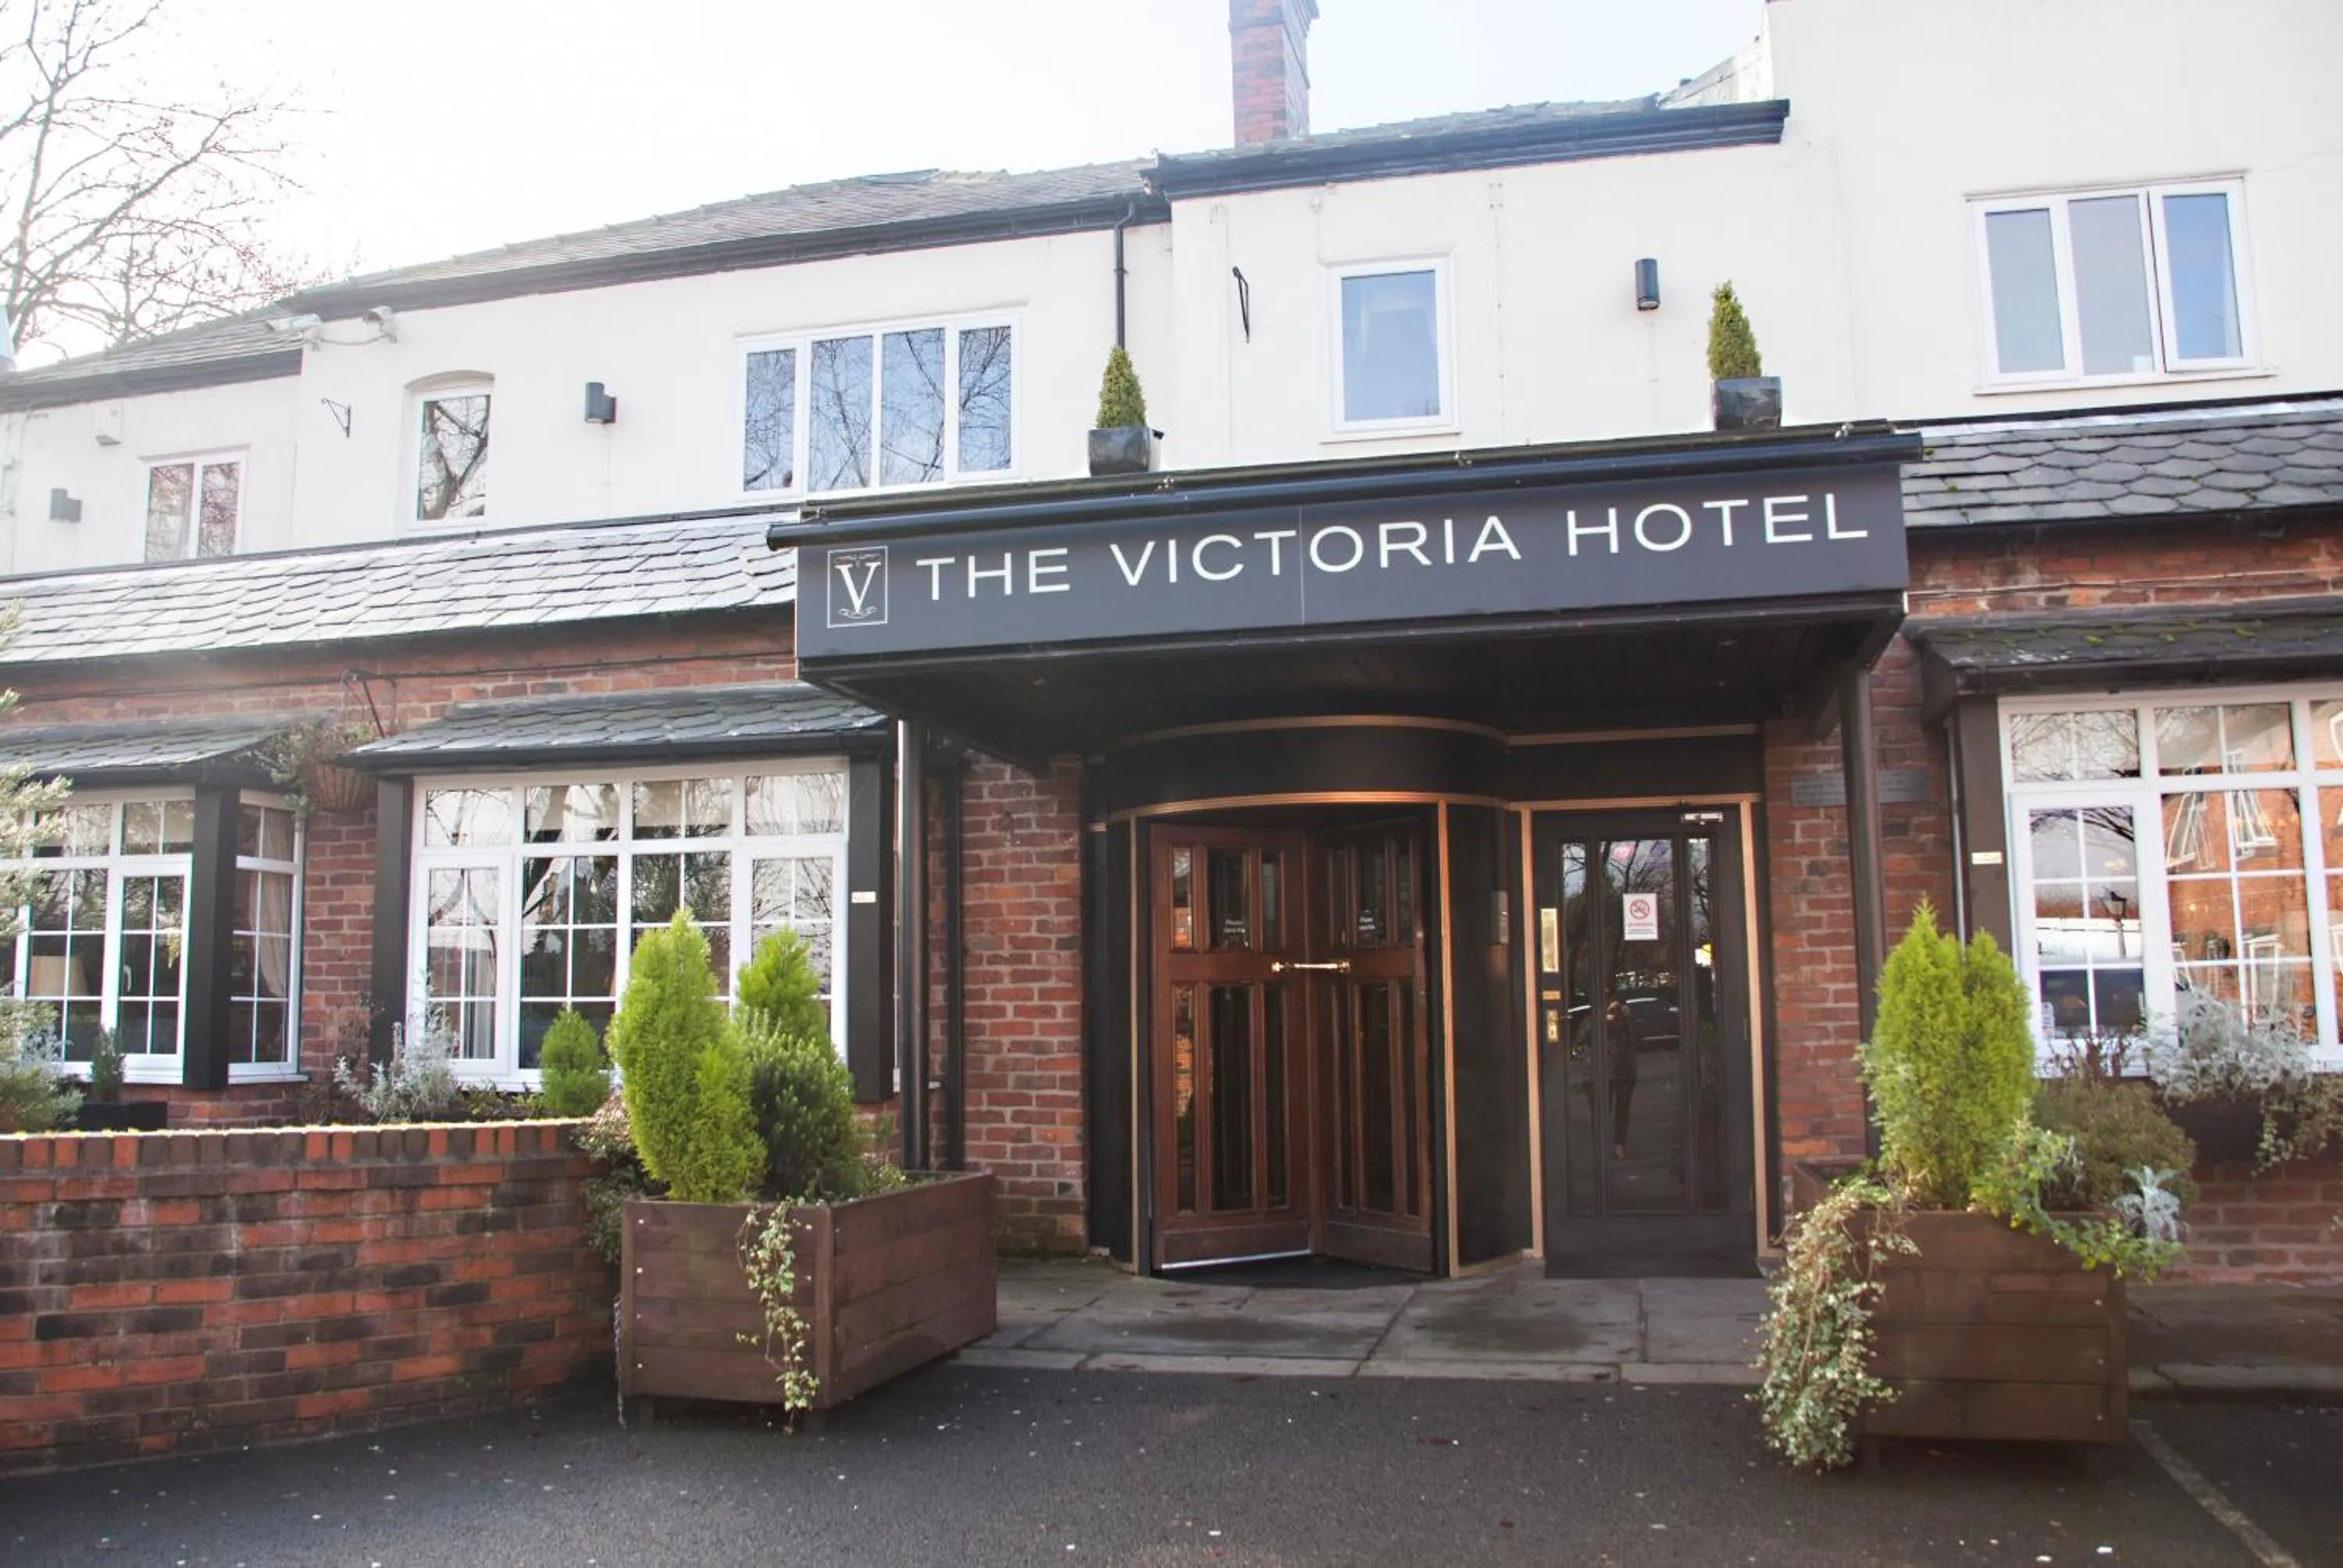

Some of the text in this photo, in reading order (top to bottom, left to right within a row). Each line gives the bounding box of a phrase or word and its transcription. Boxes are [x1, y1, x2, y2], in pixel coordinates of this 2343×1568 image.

[915, 492, 1868, 600] THE VICTORIA HOTEL
[835, 561, 882, 614] V
